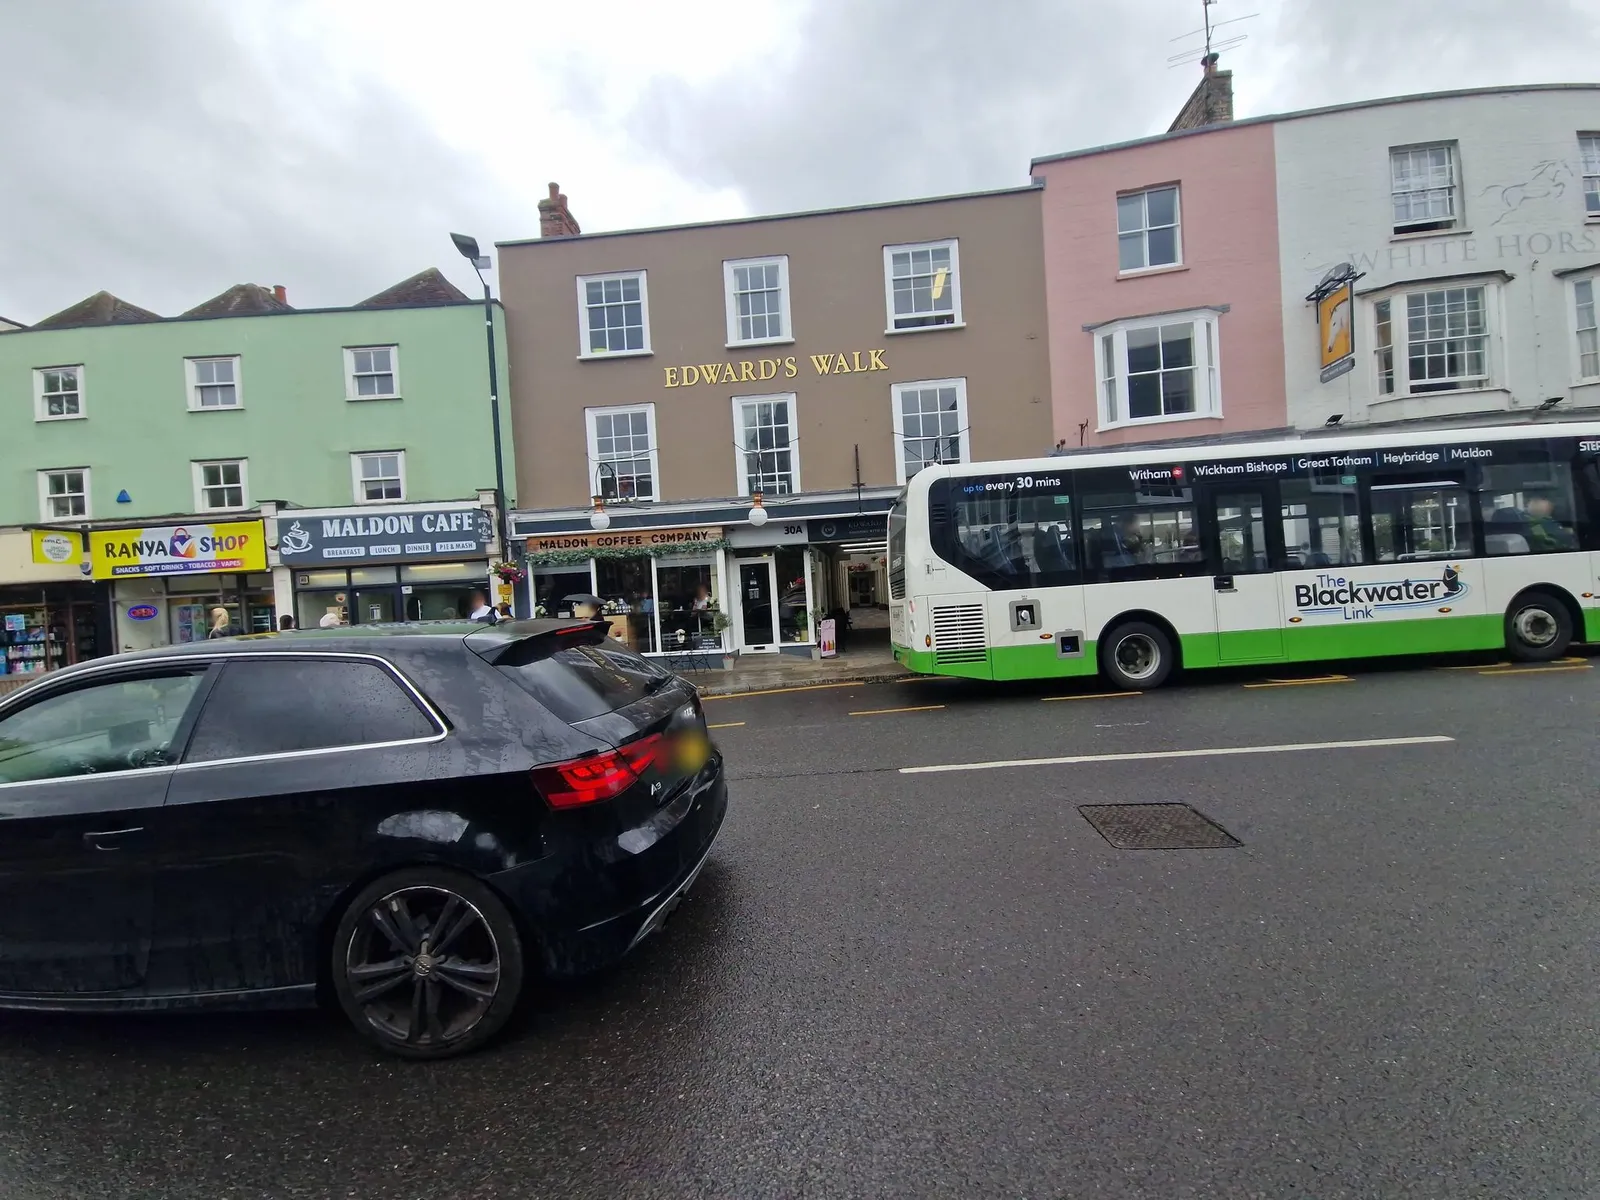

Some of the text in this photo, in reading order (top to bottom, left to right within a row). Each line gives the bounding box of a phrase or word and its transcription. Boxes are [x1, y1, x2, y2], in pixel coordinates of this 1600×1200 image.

[1348, 239, 1477, 271] WHITE
[664, 349, 889, 388] EDWARD'S WALK
[1383, 450, 1439, 465] Heybridge
[1451, 447, 1493, 459] Maldon
[1194, 462, 1287, 476] Wickham Bishops
[1298, 455, 1372, 469] Great Totham
[1129, 468, 1171, 480] Witham
[963, 476, 1061, 493] up to every 30 mins
[322, 515, 414, 538] MALDON
[421, 512, 474, 533] CAFE
[784, 525, 803, 535] 30A
[104, 534, 249, 558] RANYA SHOP
[407, 544, 430, 552] DINNER
[539, 538, 588, 549] MALDON
[597, 535, 642, 546] COFFEE
[327, 548, 361, 556] BREAKFAST
[1316, 574, 1345, 588] The
[1295, 579, 1440, 607] Blackwater
[1342, 606, 1374, 620] Link
[650, 781, 662, 796] A3
